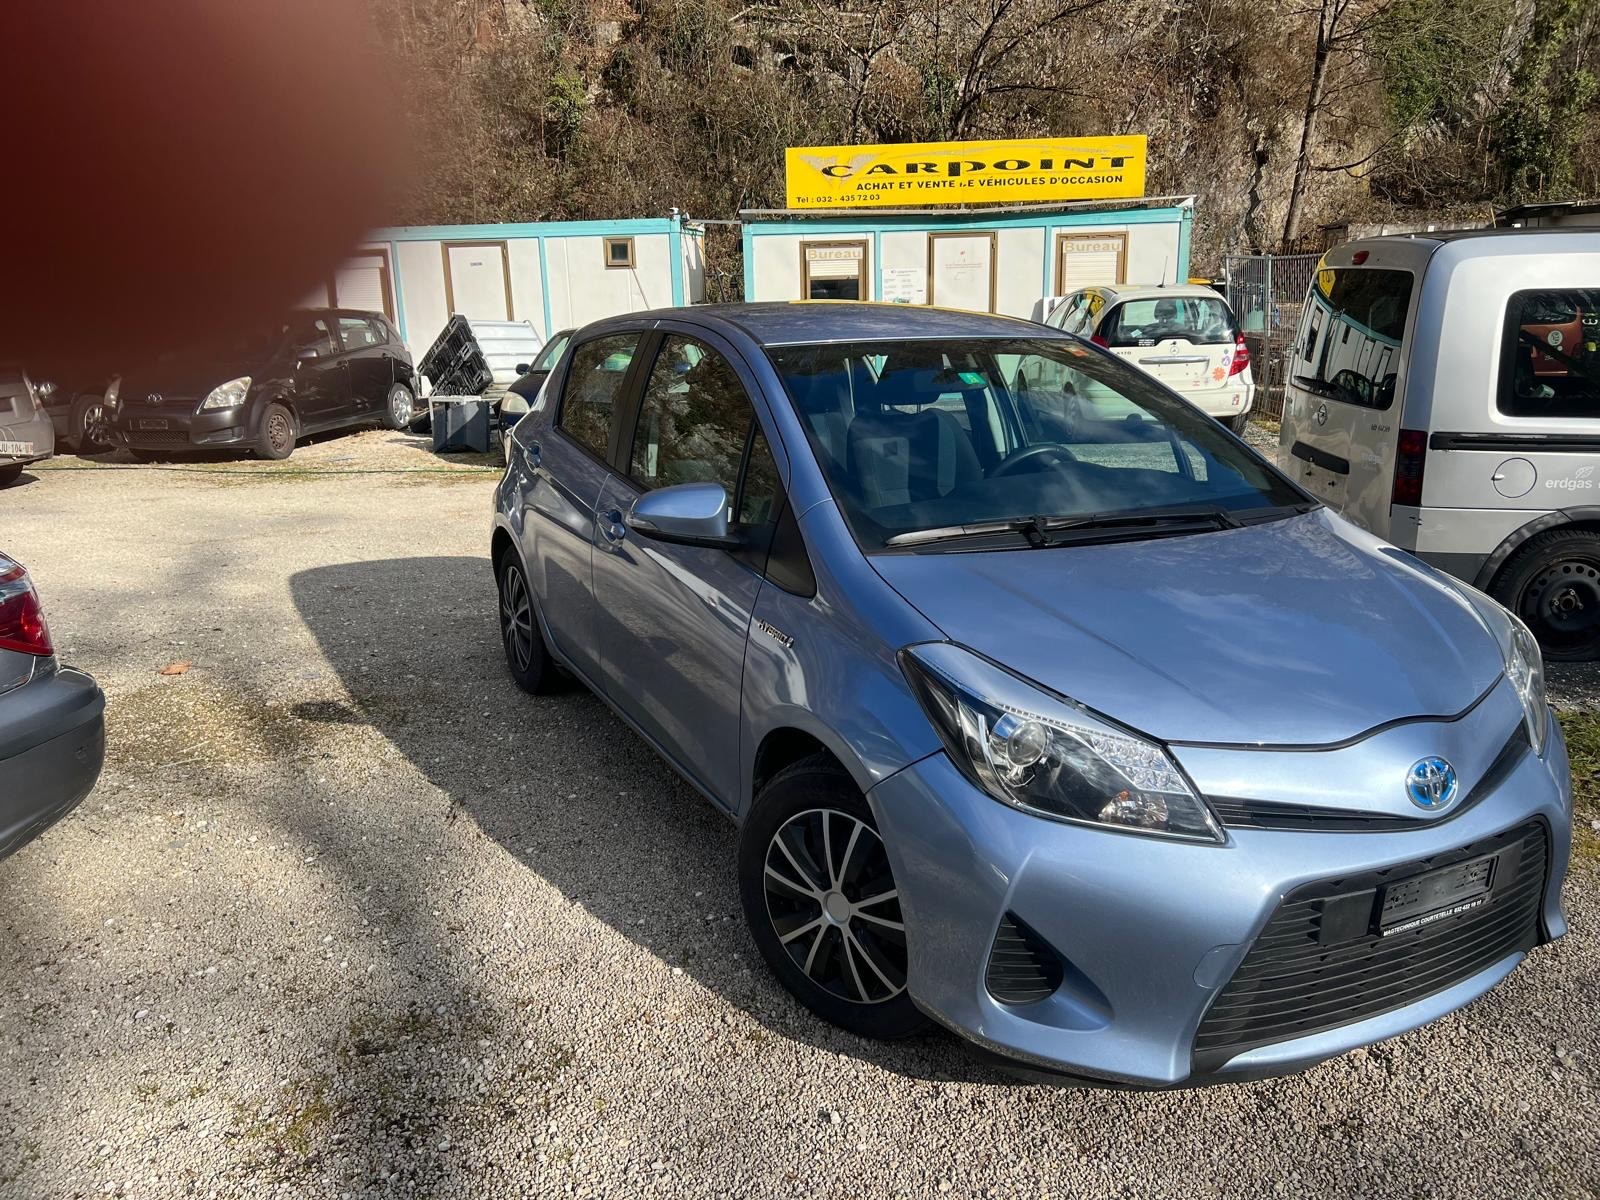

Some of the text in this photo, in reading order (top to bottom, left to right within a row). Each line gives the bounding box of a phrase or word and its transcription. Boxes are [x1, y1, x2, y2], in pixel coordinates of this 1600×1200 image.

[821, 156, 1135, 178] CARPOINT
[856, 182, 895, 191] ACHAT
[899, 181, 913, 189] ET
[917, 180, 955, 189] VENTE
[978, 176, 1046, 187] VÉHICULES
[1049, 175, 1123, 185] D'OCCASION
[808, 249, 861, 259] Bureau
[1065, 242, 1120, 252] Bureau
[1545, 477, 1593, 491] erdgas
